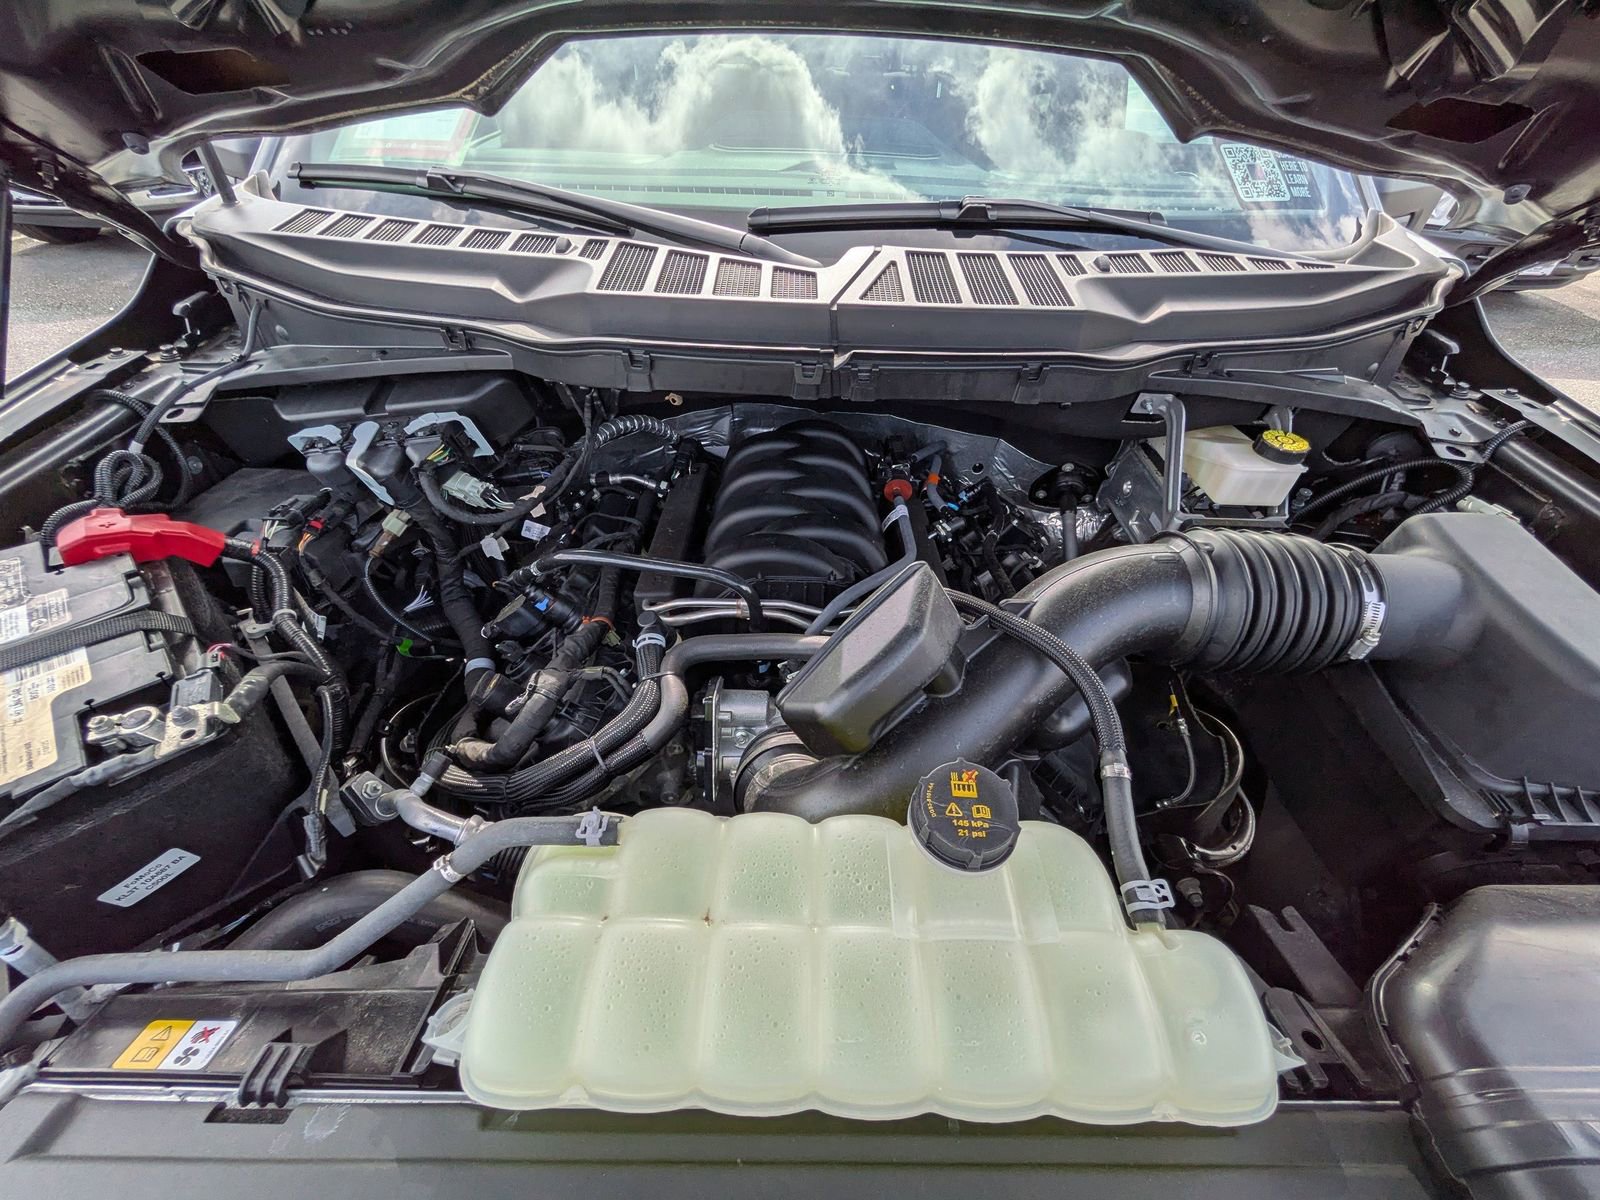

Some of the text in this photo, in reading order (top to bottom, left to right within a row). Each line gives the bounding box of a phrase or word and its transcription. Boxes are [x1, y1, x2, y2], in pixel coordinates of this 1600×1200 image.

[1280, 160, 1309, 172] HERE TO
[1285, 173, 1308, 185] LEARN
[1290, 186, 1311, 198] MORE
[952, 819, 990, 828] 145 kPa
[957, 829, 986, 838] 21 psi
[171, 855, 186, 865] BA
[123, 864, 162, 888] FoMoCo
